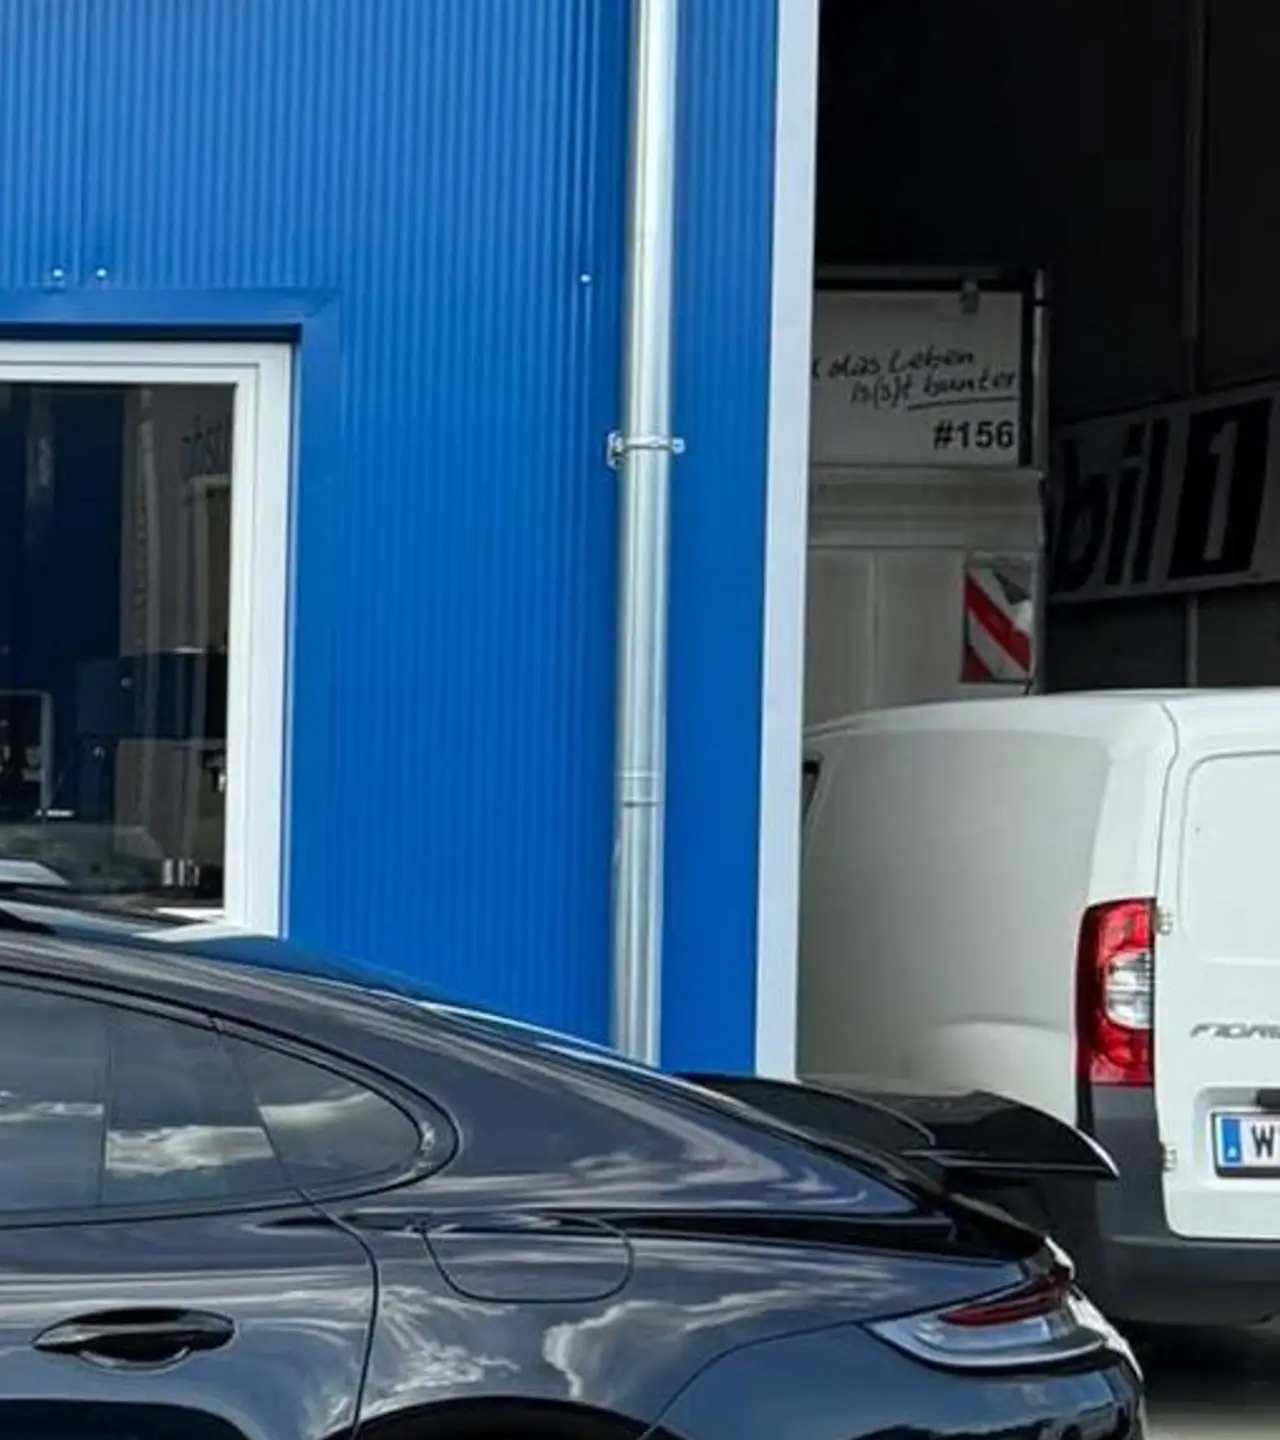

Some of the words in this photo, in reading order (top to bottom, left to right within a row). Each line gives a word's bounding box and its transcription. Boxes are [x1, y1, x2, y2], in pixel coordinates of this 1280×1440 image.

[933, 420, 1014, 450] #156
[1050, 418, 1169, 591] bil
[1202, 420, 1238, 562] 1
